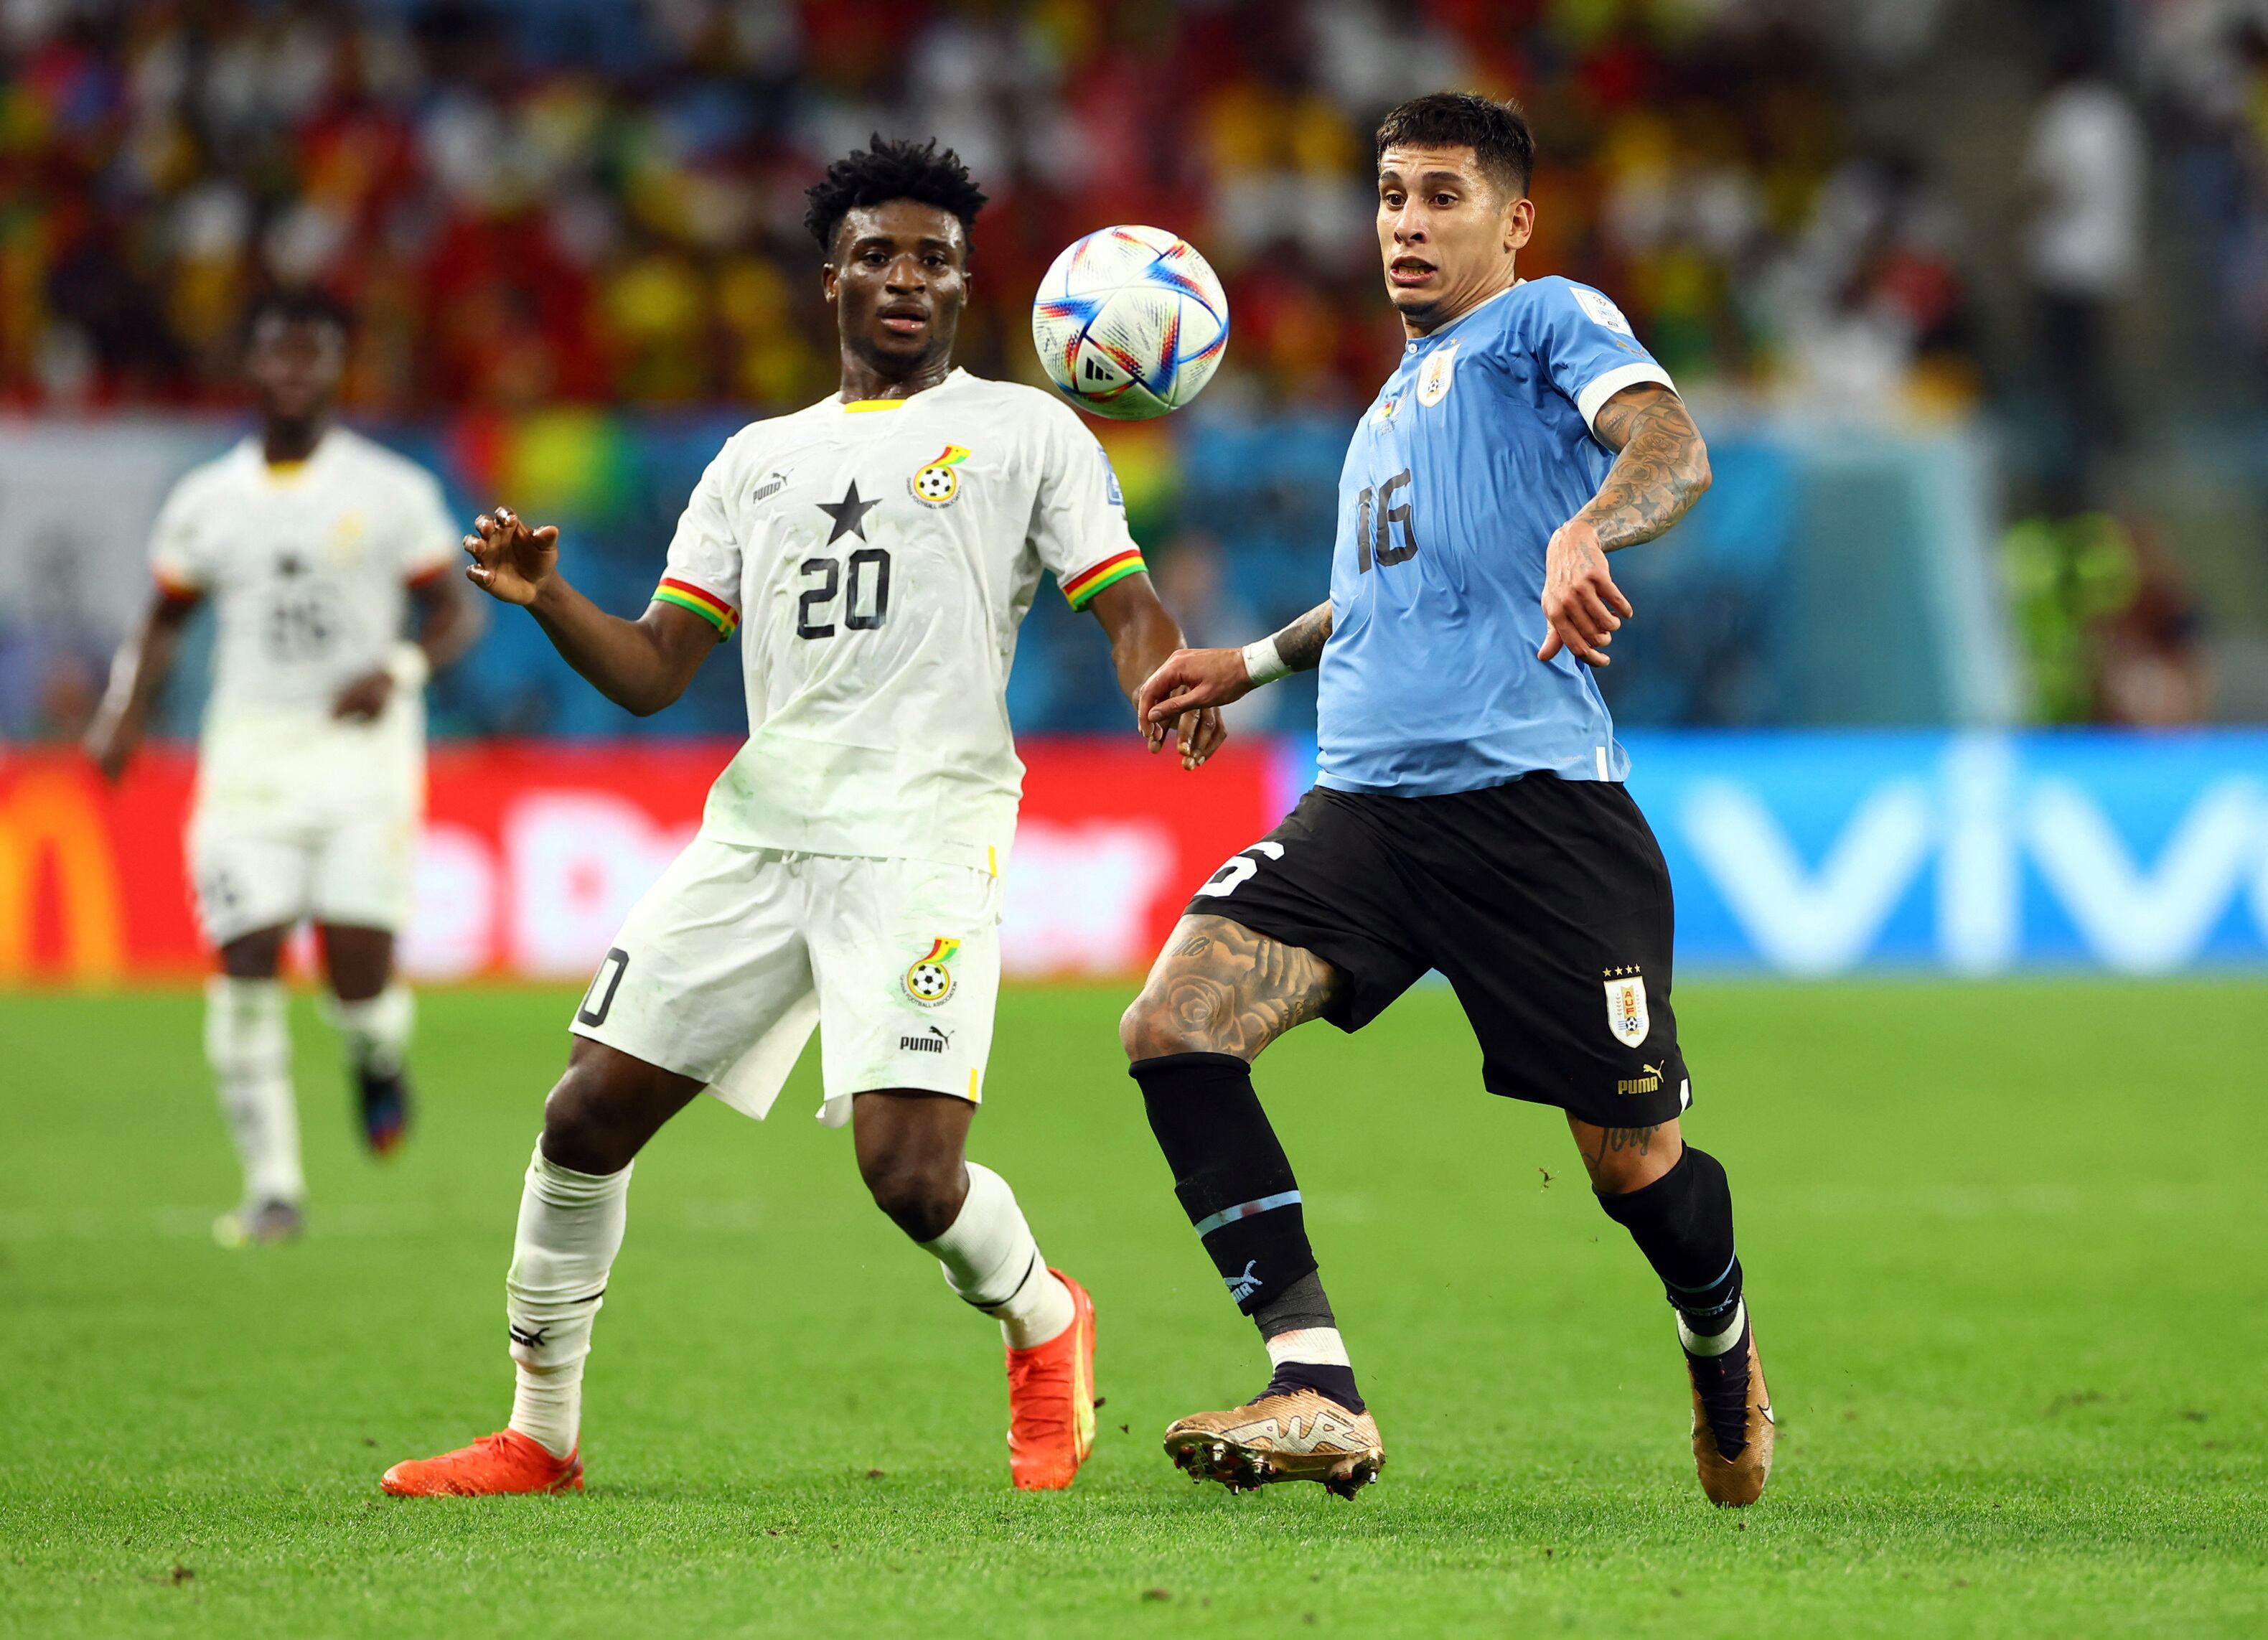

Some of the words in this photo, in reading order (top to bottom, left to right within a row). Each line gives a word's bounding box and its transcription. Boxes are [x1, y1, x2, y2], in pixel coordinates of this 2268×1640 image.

[1357, 467, 1418, 575] 16
[797, 548, 891, 640] 20
[1678, 726, 2268, 978] viv
[905, 993, 932, 1008] FOOTBALL
[933, 981, 957, 1008] ASSOCIATION
[1624, 990, 1634, 1016] AUF
[900, 1036, 943, 1054] PUMA
[1618, 1076, 1658, 1095] PUMA
